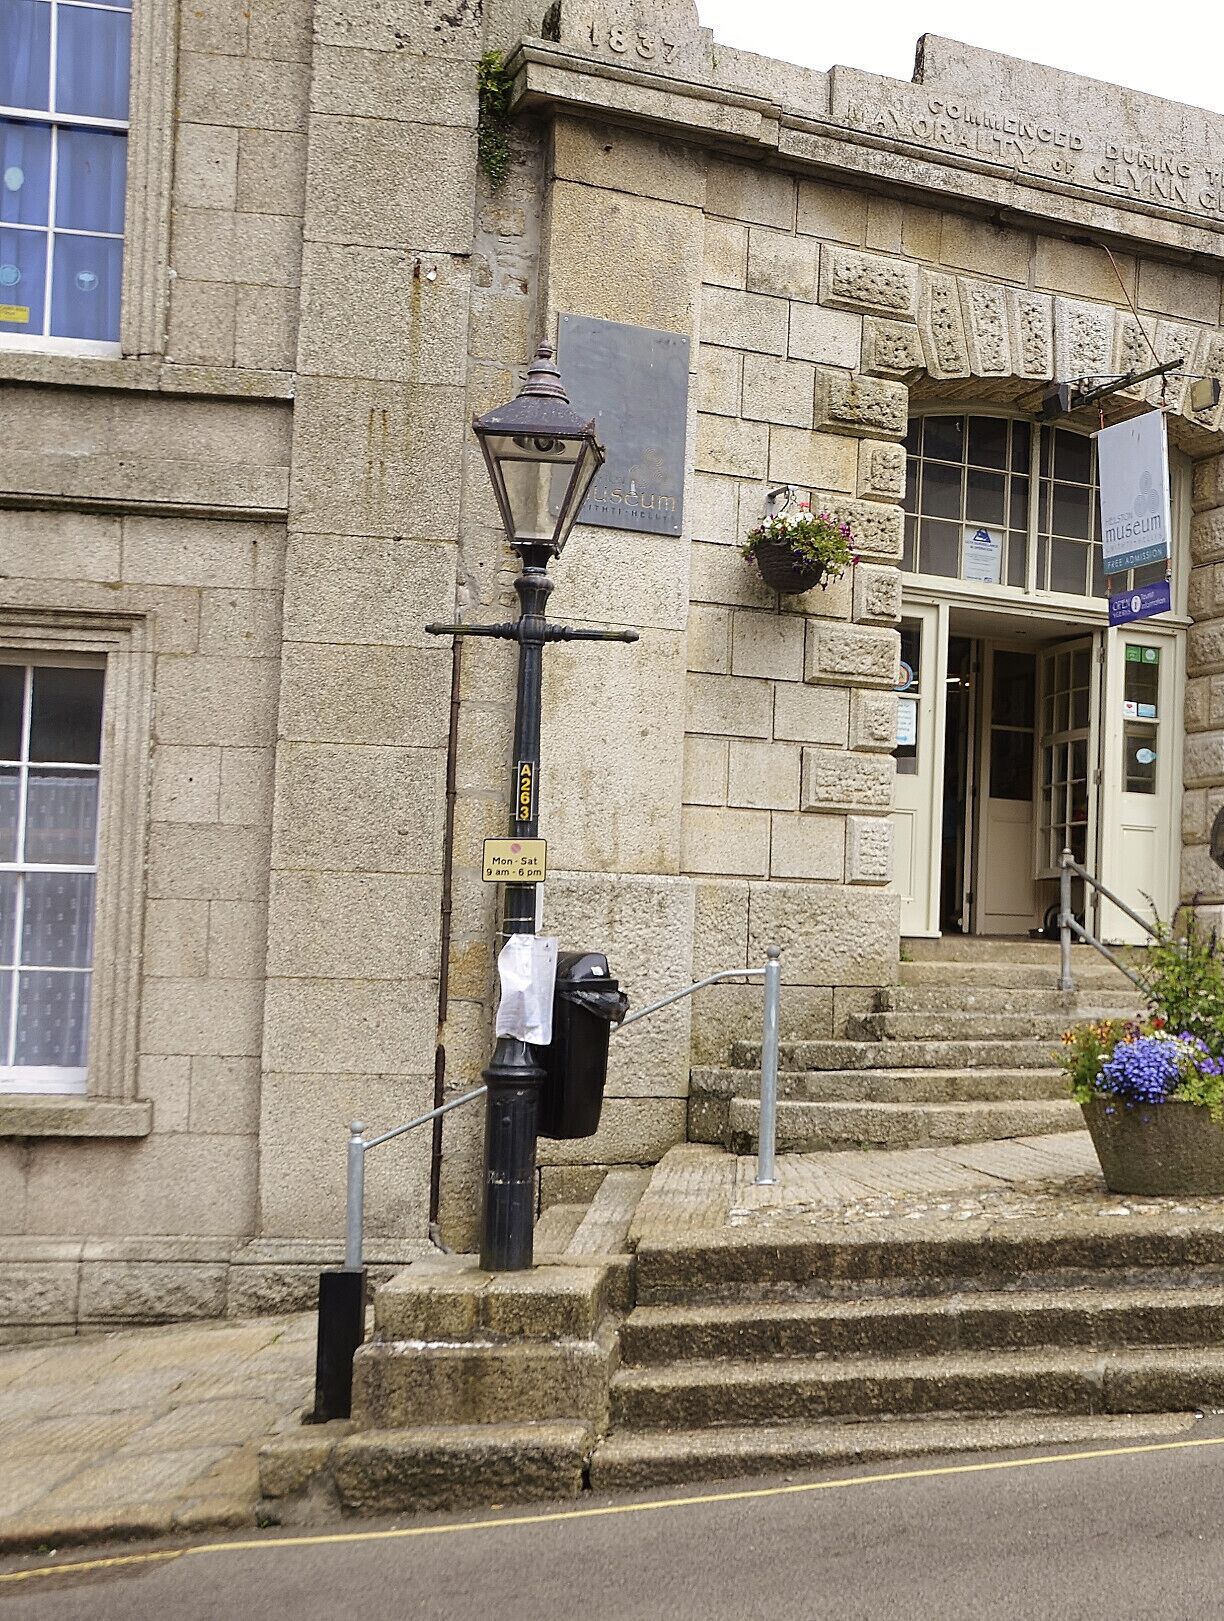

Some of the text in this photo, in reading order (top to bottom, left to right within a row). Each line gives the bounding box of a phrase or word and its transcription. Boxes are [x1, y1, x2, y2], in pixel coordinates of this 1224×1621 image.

[587, 21, 679, 64] 1837
[847, 104, 1036, 164] MAYORALTY
[1093, 163, 1188, 203] GLYNN
[928, 101, 1084, 151] COMMENCED
[1105, 142, 1191, 178] DURING
[587, 485, 676, 512] useum
[1105, 515, 1161, 543] museum
[520, 764, 532, 820] A263
[492, 857, 513, 865] Mon
[521, 857, 538, 865] Sat
[518, 868, 524, 876] 6
[527, 869, 542, 877] pm
